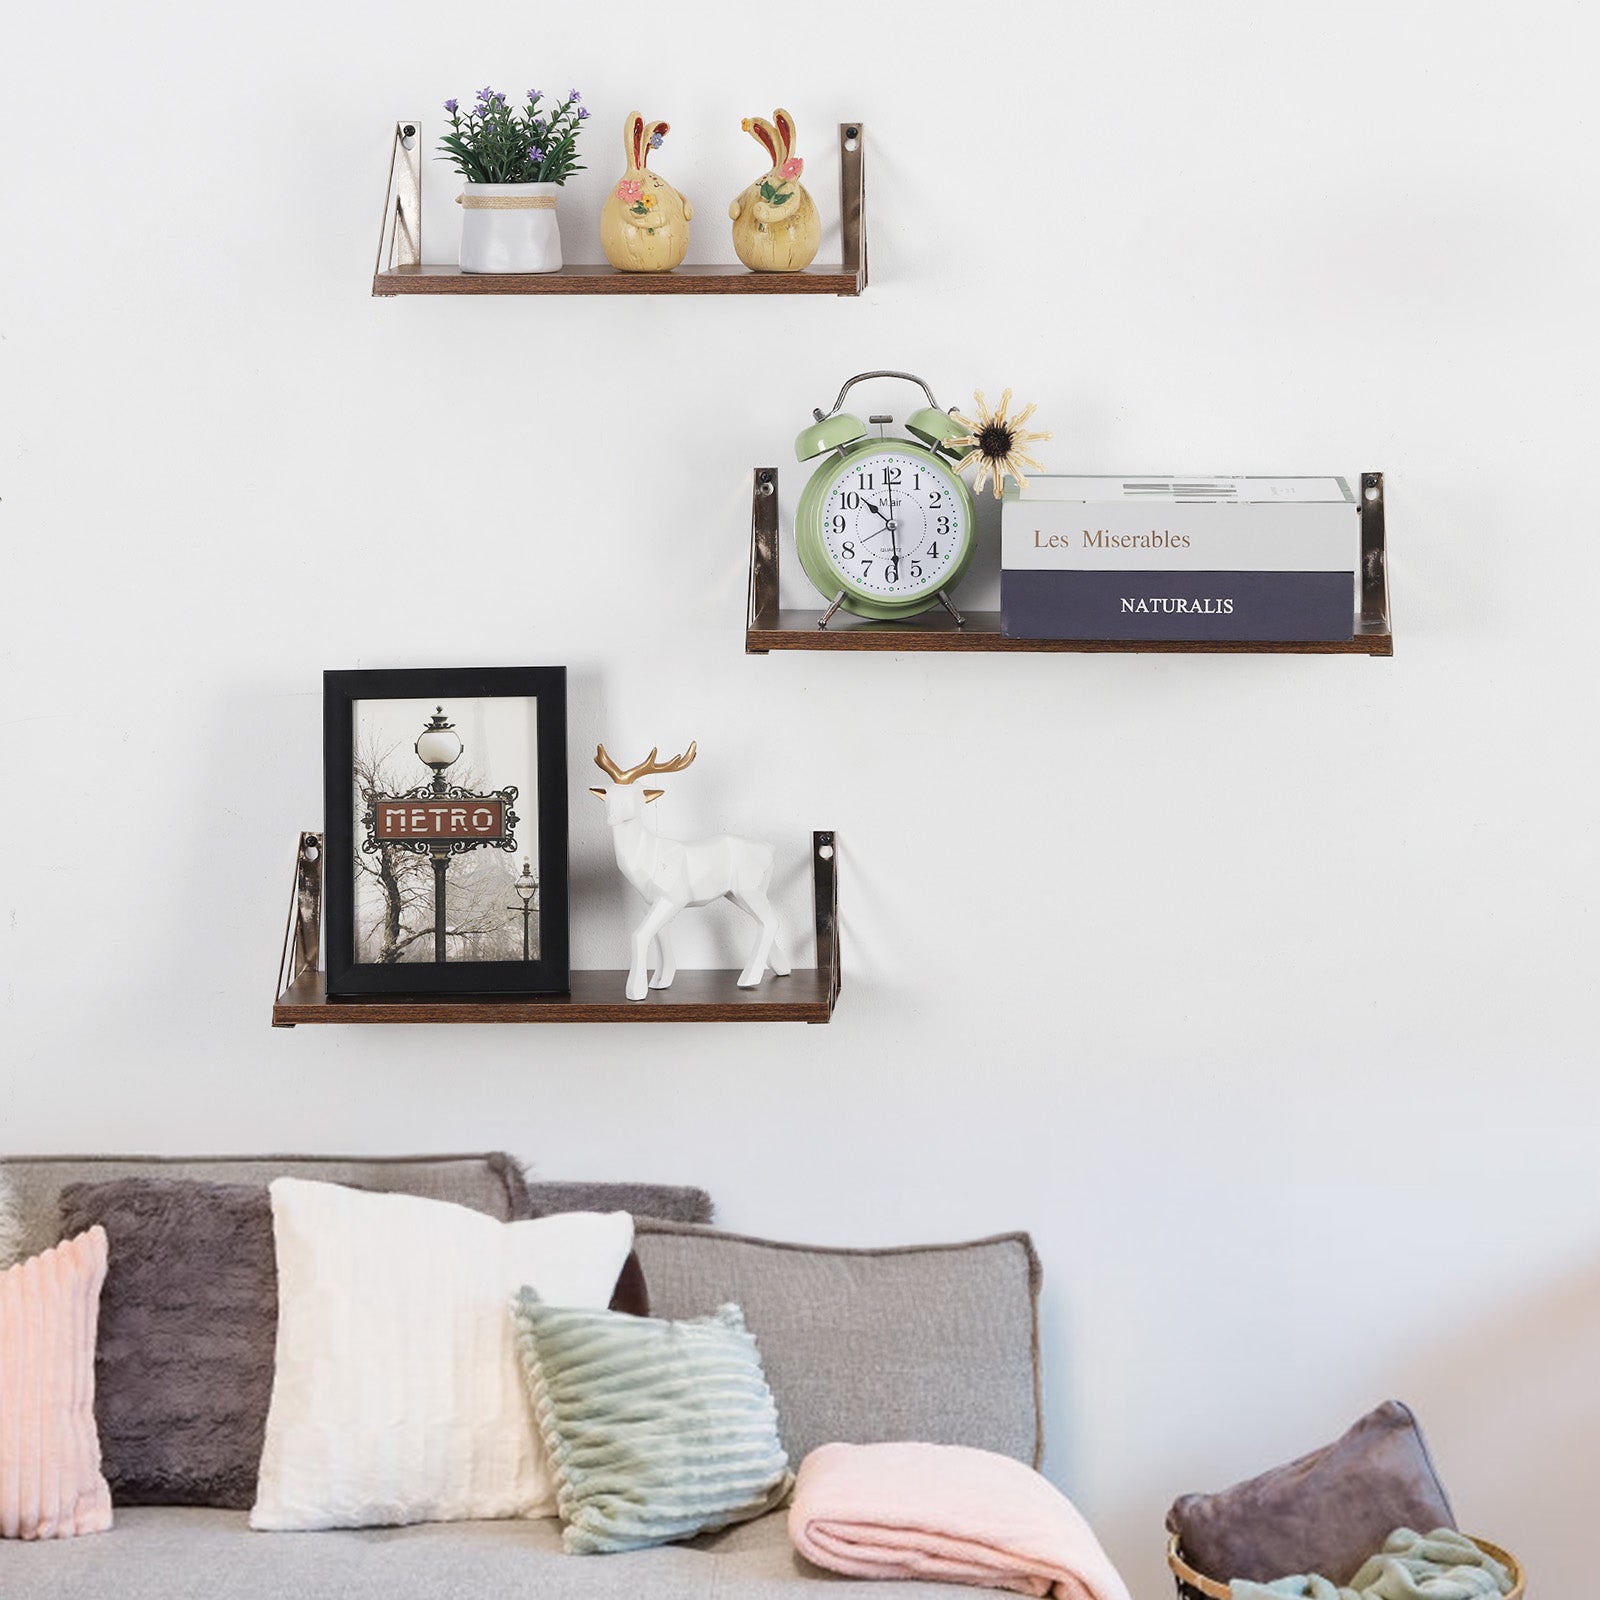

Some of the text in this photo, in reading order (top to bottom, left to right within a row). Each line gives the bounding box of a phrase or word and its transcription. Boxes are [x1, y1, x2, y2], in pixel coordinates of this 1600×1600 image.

[859, 473, 875, 490] 11
[882, 467, 901, 485] 12
[913, 473, 921, 490] 1
[840, 491, 860, 510] 10
[929, 492, 942, 509] 2
[832, 515, 846, 534] 9
[937, 516, 950, 535] 3
[1034, 529, 1191, 549] Les Miserables
[842, 541, 855, 559] 8
[926, 542, 939, 559] 4
[861, 560, 873, 577] 7
[885, 565, 898, 584] 6
[910, 560, 922, 578] 5
[1120, 598, 1234, 615] NATURALIS
[385, 807, 494, 833] METRO
